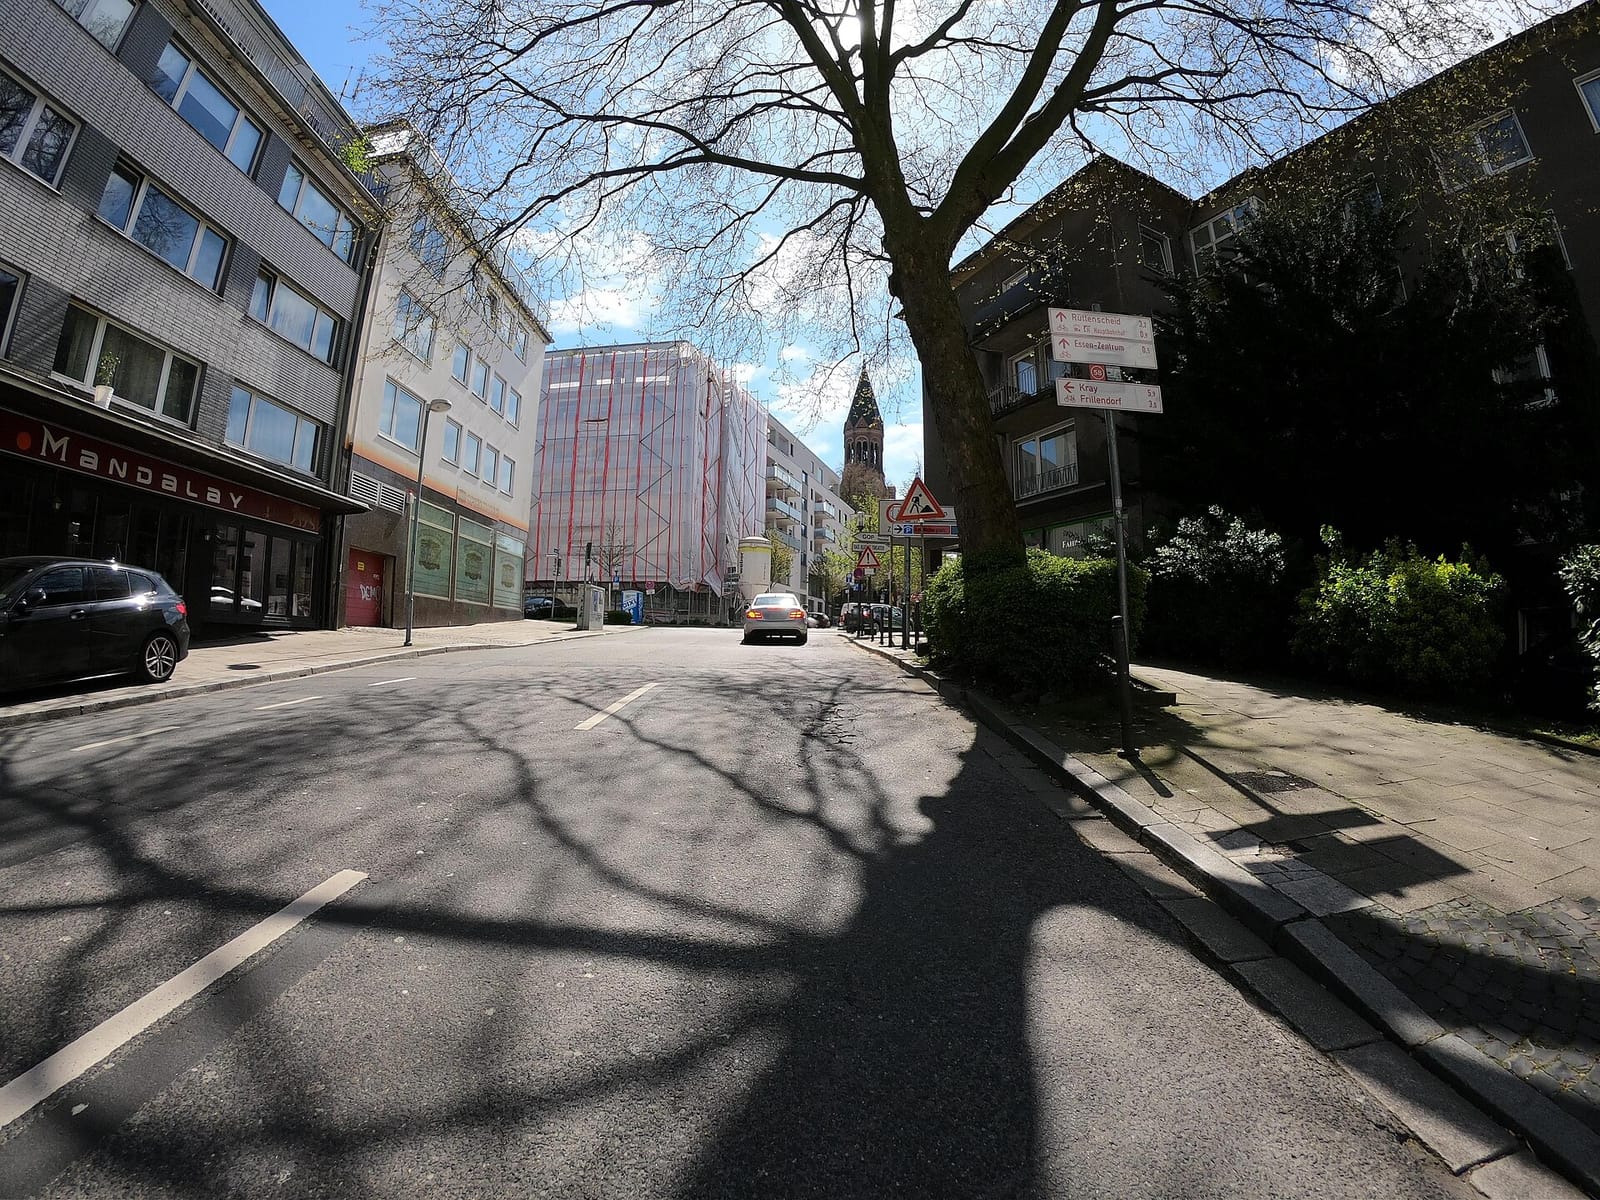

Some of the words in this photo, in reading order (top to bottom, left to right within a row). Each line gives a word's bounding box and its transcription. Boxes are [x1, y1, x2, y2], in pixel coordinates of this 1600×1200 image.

[1071, 313, 1121, 325] Rüttenscheid
[1074, 339, 1125, 351] Essen-Zentrum
[1079, 383, 1098, 394] Kray
[1080, 395, 1122, 406] Frillendorf
